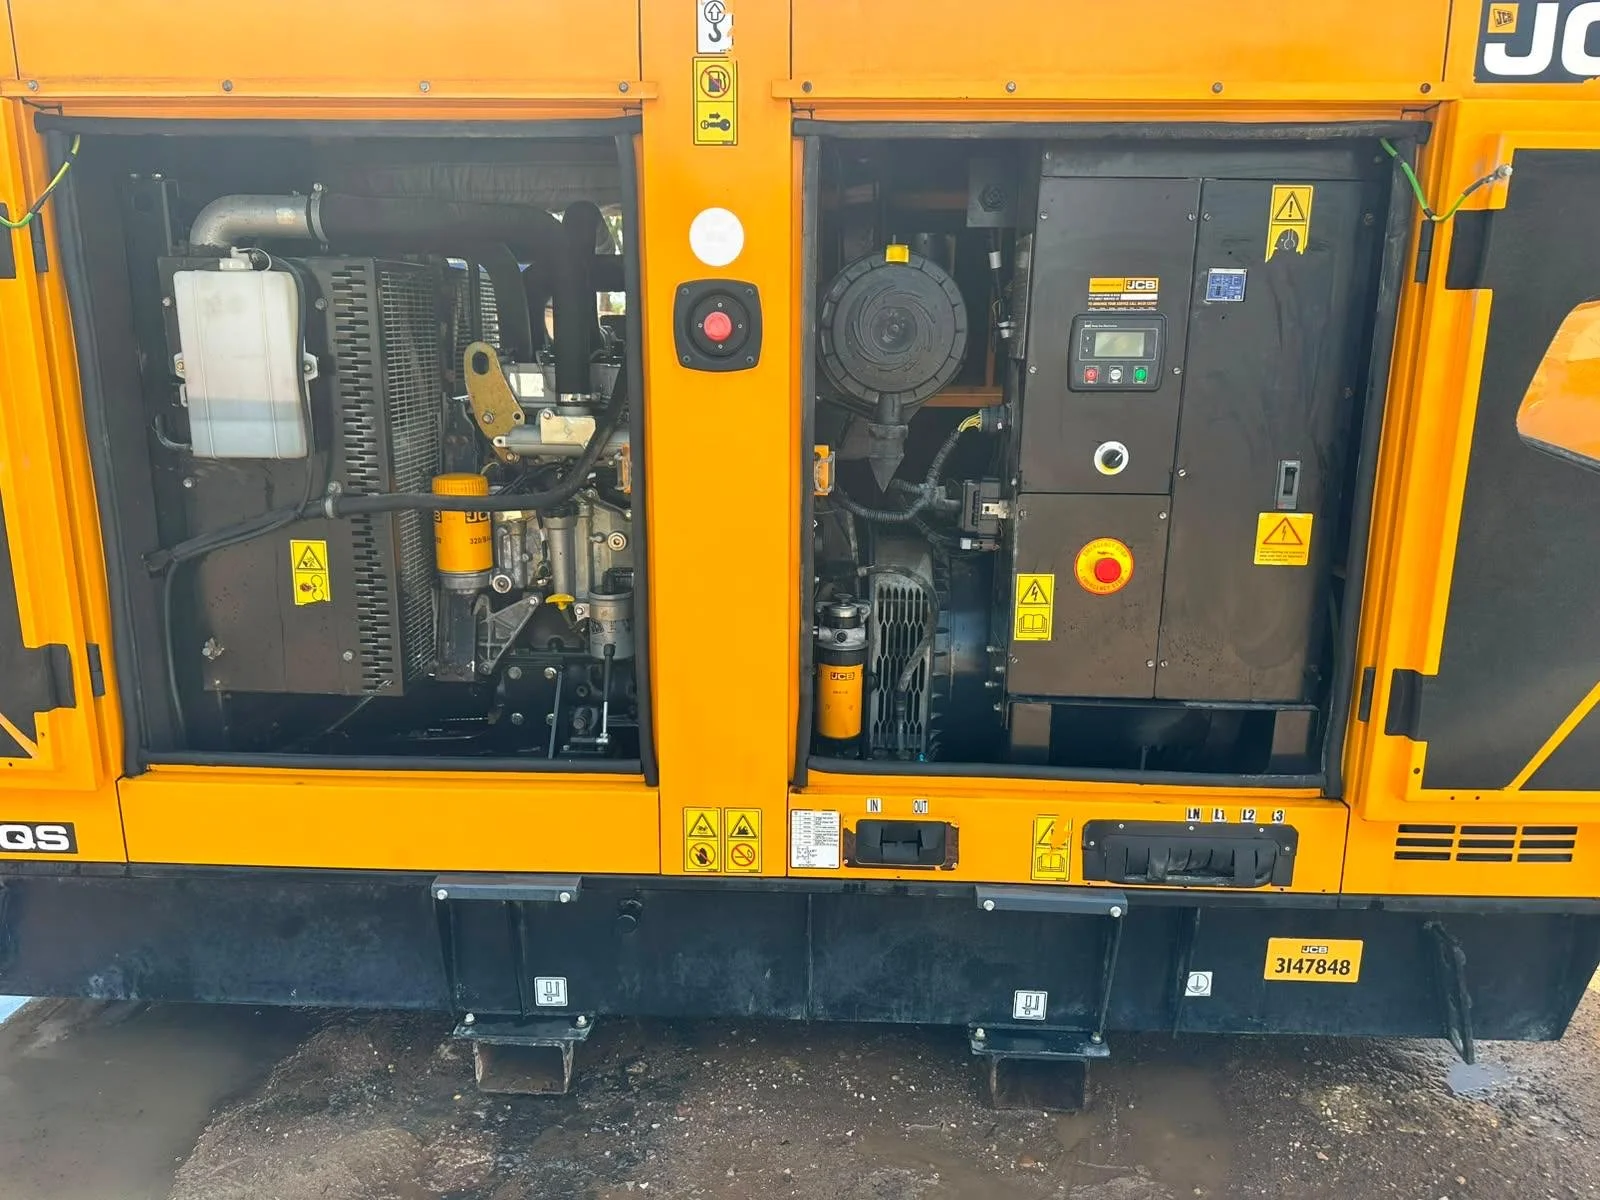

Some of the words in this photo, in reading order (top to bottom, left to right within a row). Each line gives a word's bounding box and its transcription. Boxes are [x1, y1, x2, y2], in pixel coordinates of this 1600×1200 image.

[1127, 280, 1156, 290] JCB
[466, 511, 490, 522] JC
[870, 799, 879, 812] IN
[914, 800, 927, 813] OUT
[1188, 808, 1201, 820] LN
[1214, 808, 1226, 820] L1
[1242, 808, 1256, 820] L2
[0, 824, 70, 850] QS
[1302, 946, 1328, 954] JCB
[1275, 957, 1351, 975] 3147848
